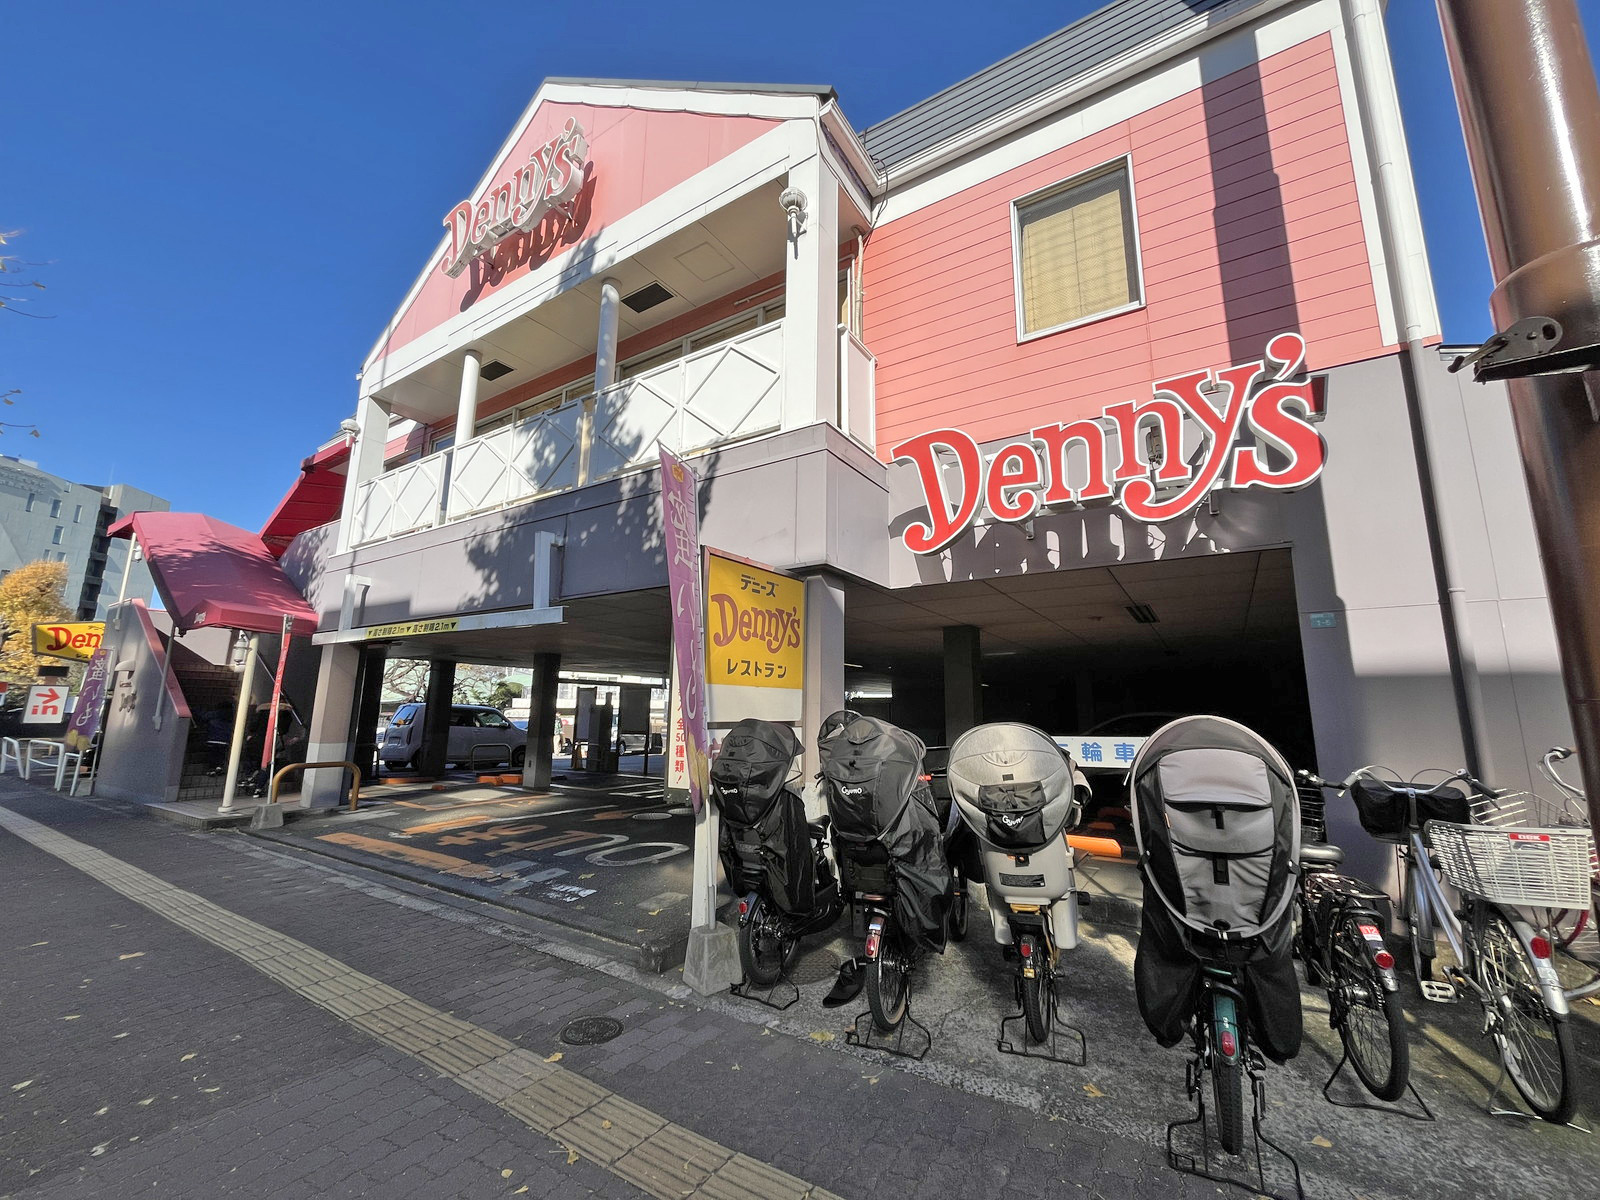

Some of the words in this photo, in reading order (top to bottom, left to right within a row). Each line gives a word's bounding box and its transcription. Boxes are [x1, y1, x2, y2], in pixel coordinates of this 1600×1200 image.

[441, 117, 580, 277] Denny's
[891, 332, 1328, 555] Denny's
[741, 574, 779, 597] デニーズ
[711, 593, 801, 654] Denny's
[46, 627, 102, 651] Den
[728, 658, 787, 679] レストラン
[31, 705, 58, 715] in
